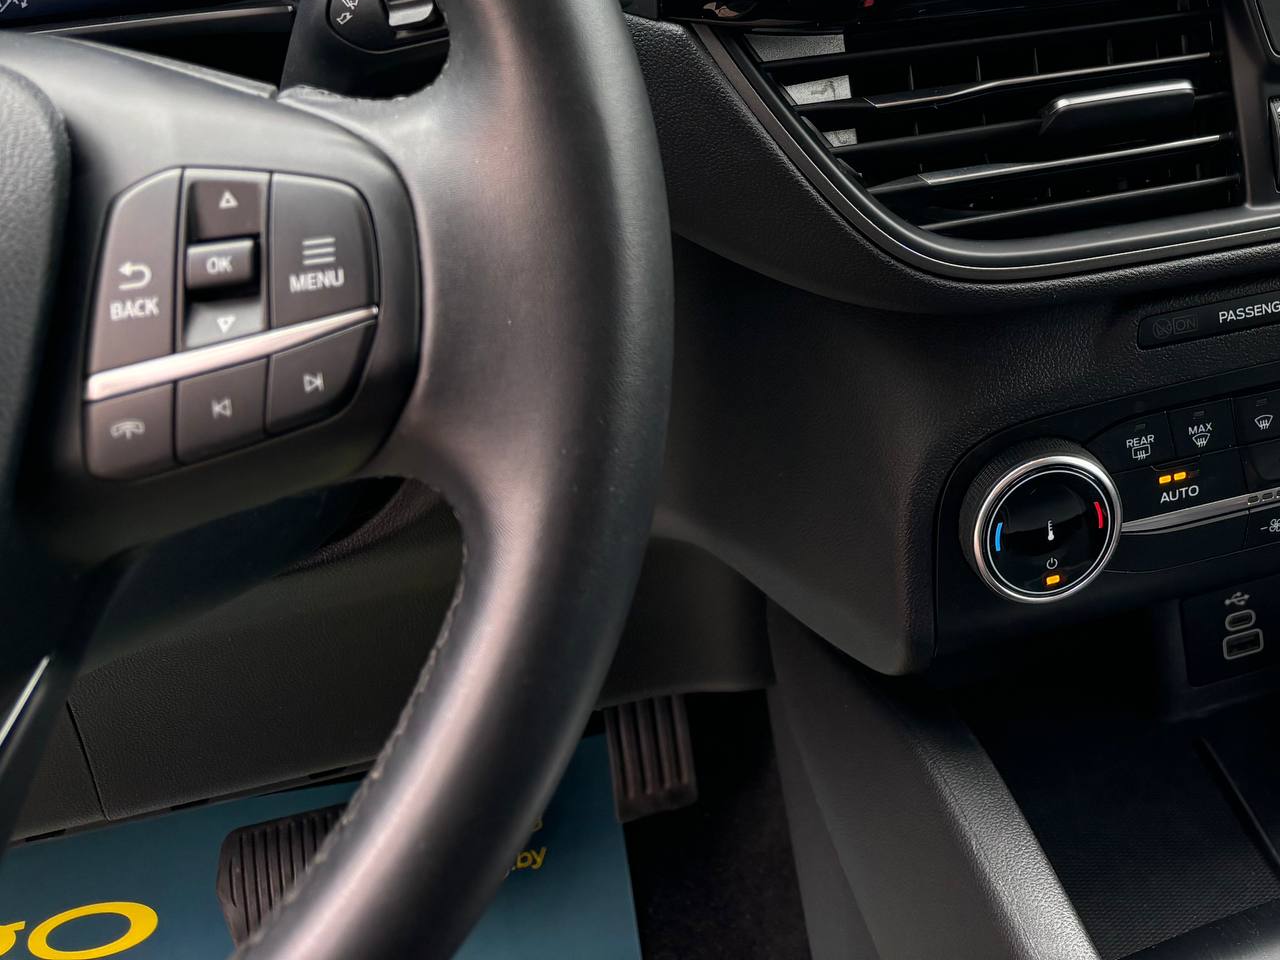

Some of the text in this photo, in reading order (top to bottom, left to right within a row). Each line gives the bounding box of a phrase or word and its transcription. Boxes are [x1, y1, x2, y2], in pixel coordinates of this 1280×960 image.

[206, 255, 232, 275] OK
[289, 269, 345, 293] MENU
[109, 297, 160, 322] BACK
[1188, 422, 1213, 436] MAX
[1126, 434, 1155, 449] REAR
[1160, 485, 1200, 504] AUTO
